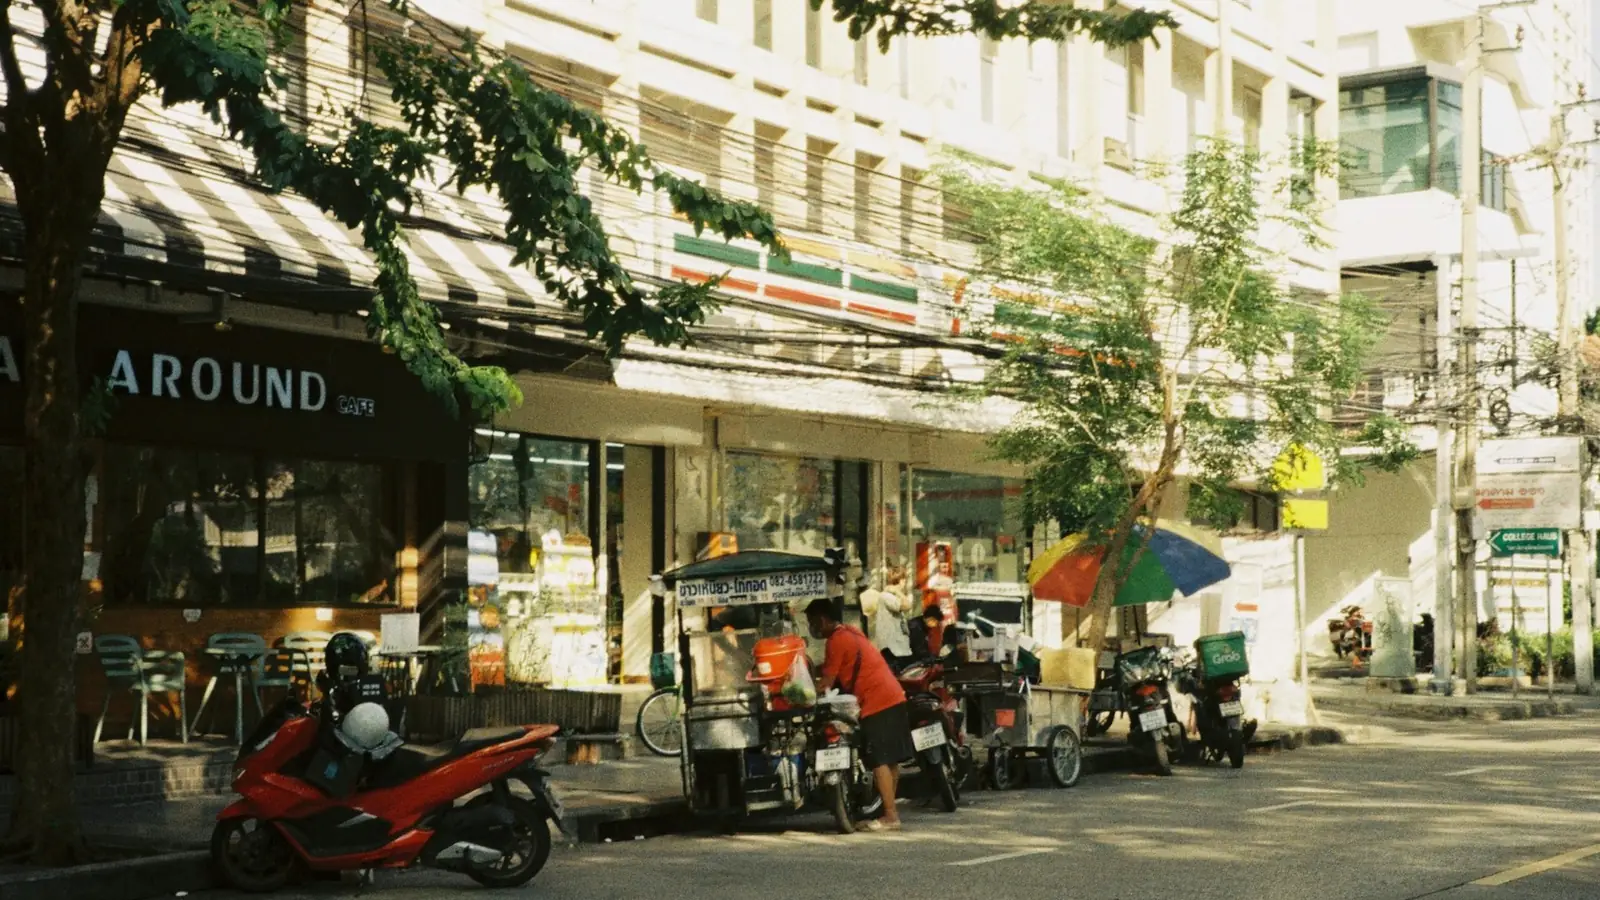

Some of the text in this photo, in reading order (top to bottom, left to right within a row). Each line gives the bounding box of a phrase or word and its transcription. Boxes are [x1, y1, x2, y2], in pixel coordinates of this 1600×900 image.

[108, 350, 327, 411] AROUND
[338, 396, 375, 417] CAFE
[1212, 651, 1241, 665] Grab
